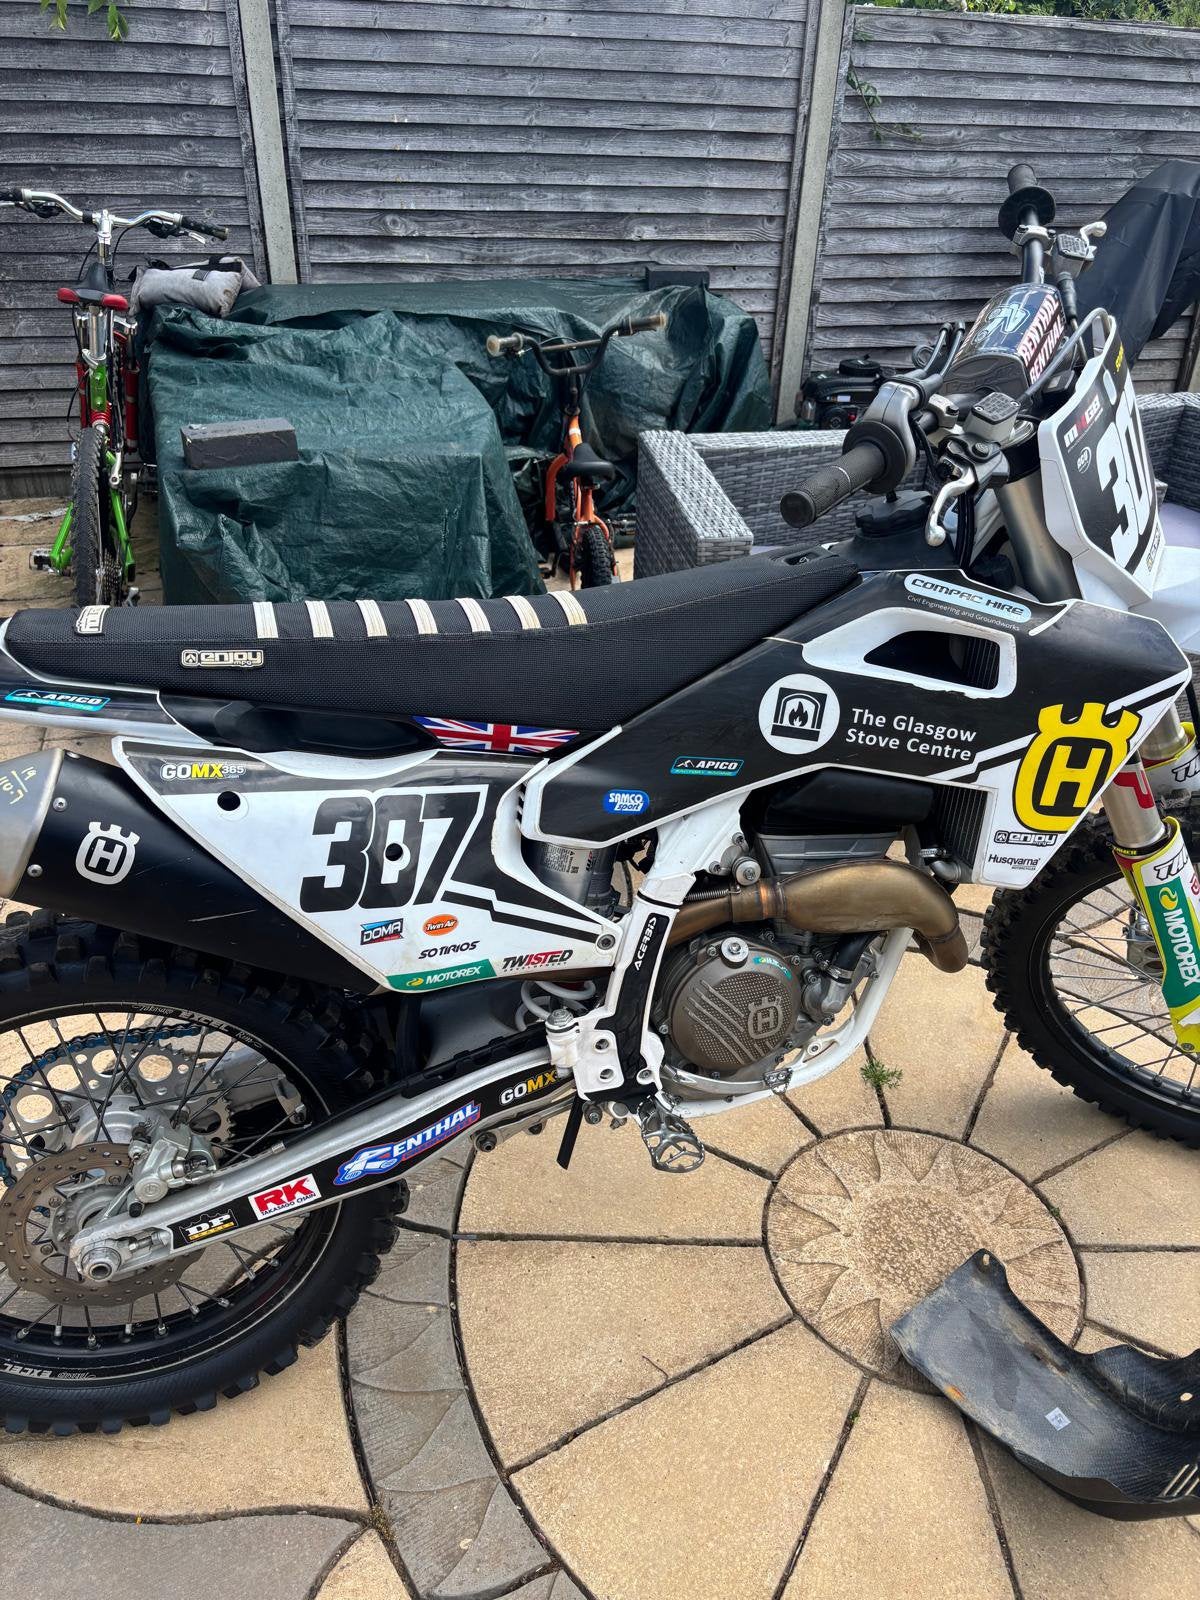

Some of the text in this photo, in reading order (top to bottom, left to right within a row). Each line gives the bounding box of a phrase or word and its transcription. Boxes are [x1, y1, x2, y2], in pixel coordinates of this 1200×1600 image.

[1017, 294, 1059, 368] RENTHAL
[1029, 314, 1065, 385] RENTHAL
[911, 578, 1024, 616] COMPAC HIRE
[907, 595, 1020, 631] Civil Engineering and Groundworks
[201, 652, 262, 665] enjoy
[42, 693, 103, 705] APICO
[852, 708, 977, 742] The Glasgow
[845, 728, 972, 761] Stove Centre
[161, 763, 245, 780] GOMX365
[695, 759, 738, 770] APICO
[608, 792, 643, 803] SAMCO
[617, 803, 641, 811] sport
[1008, 833, 1057, 845] enjoy
[299, 791, 481, 914] 307
[988, 853, 1040, 866] Husqvarna
[363, 920, 402, 943] DOMA
[426, 919, 457, 932] Twin Air
[634, 916, 657, 972] ACERBIS
[1163, 907, 1200, 987] MOTOREX
[501, 949, 574, 970] TWISTED
[426, 965, 482, 985] MOTOREX
[179, 1009, 231, 1033] EXCEL
[500, 1070, 557, 1106] GOMX
[253, 1176, 314, 1213] RK
[260, 1192, 317, 1217] TAKASAGO CHAIN
[185, 1214, 232, 1236] DP
[3, 1363, 53, 1379] EXCEL
